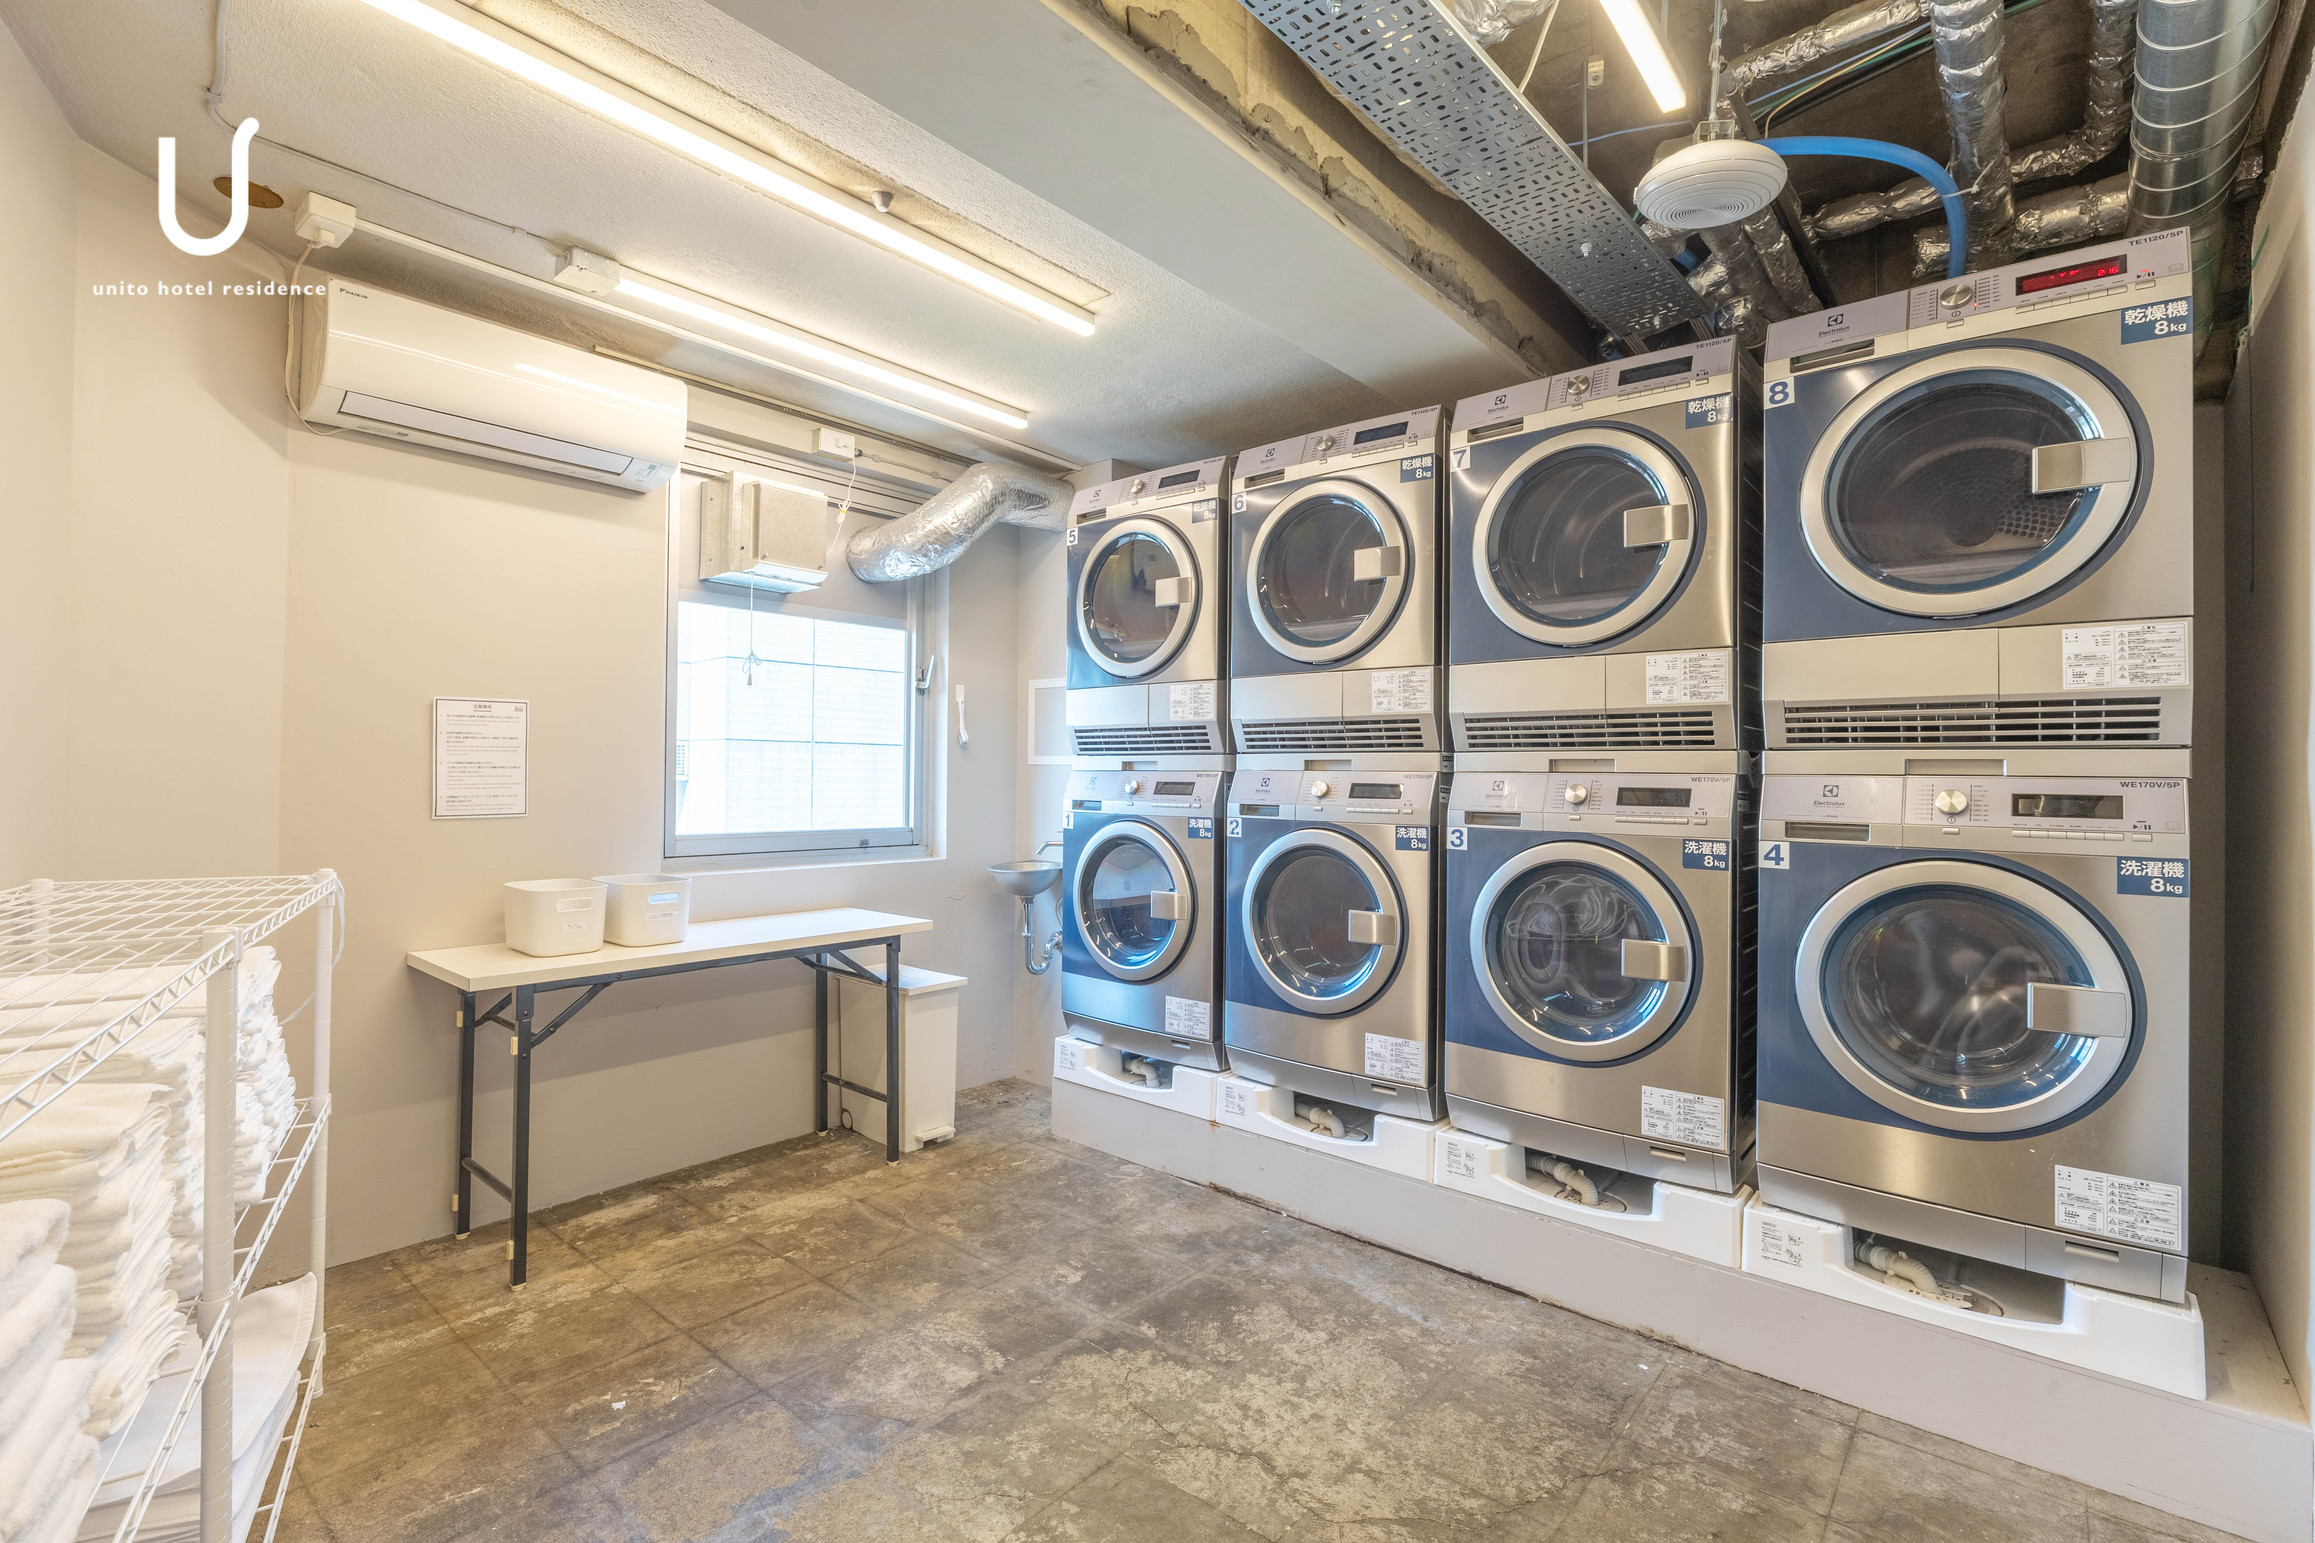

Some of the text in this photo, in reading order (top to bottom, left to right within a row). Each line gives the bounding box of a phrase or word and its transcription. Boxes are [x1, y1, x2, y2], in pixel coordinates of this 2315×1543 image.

[2128, 231, 2184, 246] TE1120/5P
[345, 290, 368, 299] DAIKIN
[2124, 300, 2189, 325] 乾燥機
[1818, 326, 1850, 336] Electrolux
[1769, 381, 1790, 405] 8
[1688, 396, 1729, 414] 乾燥機
[1402, 456, 1432, 470] 乾燥機
[1453, 449, 1467, 468] 7
[1233, 494, 1244, 511] 6
[1068, 530, 1076, 543] 5
[2119, 781, 2181, 789] WE170V/5P
[1065, 813, 1070, 827] 1
[1189, 818, 1212, 828] 洗濯機
[1229, 819, 1240, 836] 2
[1397, 827, 1427, 839] 洗濯機
[1450, 829, 1464, 848] 3
[1684, 840, 1727, 856] 洗濯機
[1763, 843, 1785, 866] 4
[2120, 860, 2185, 878] 洗濯機
